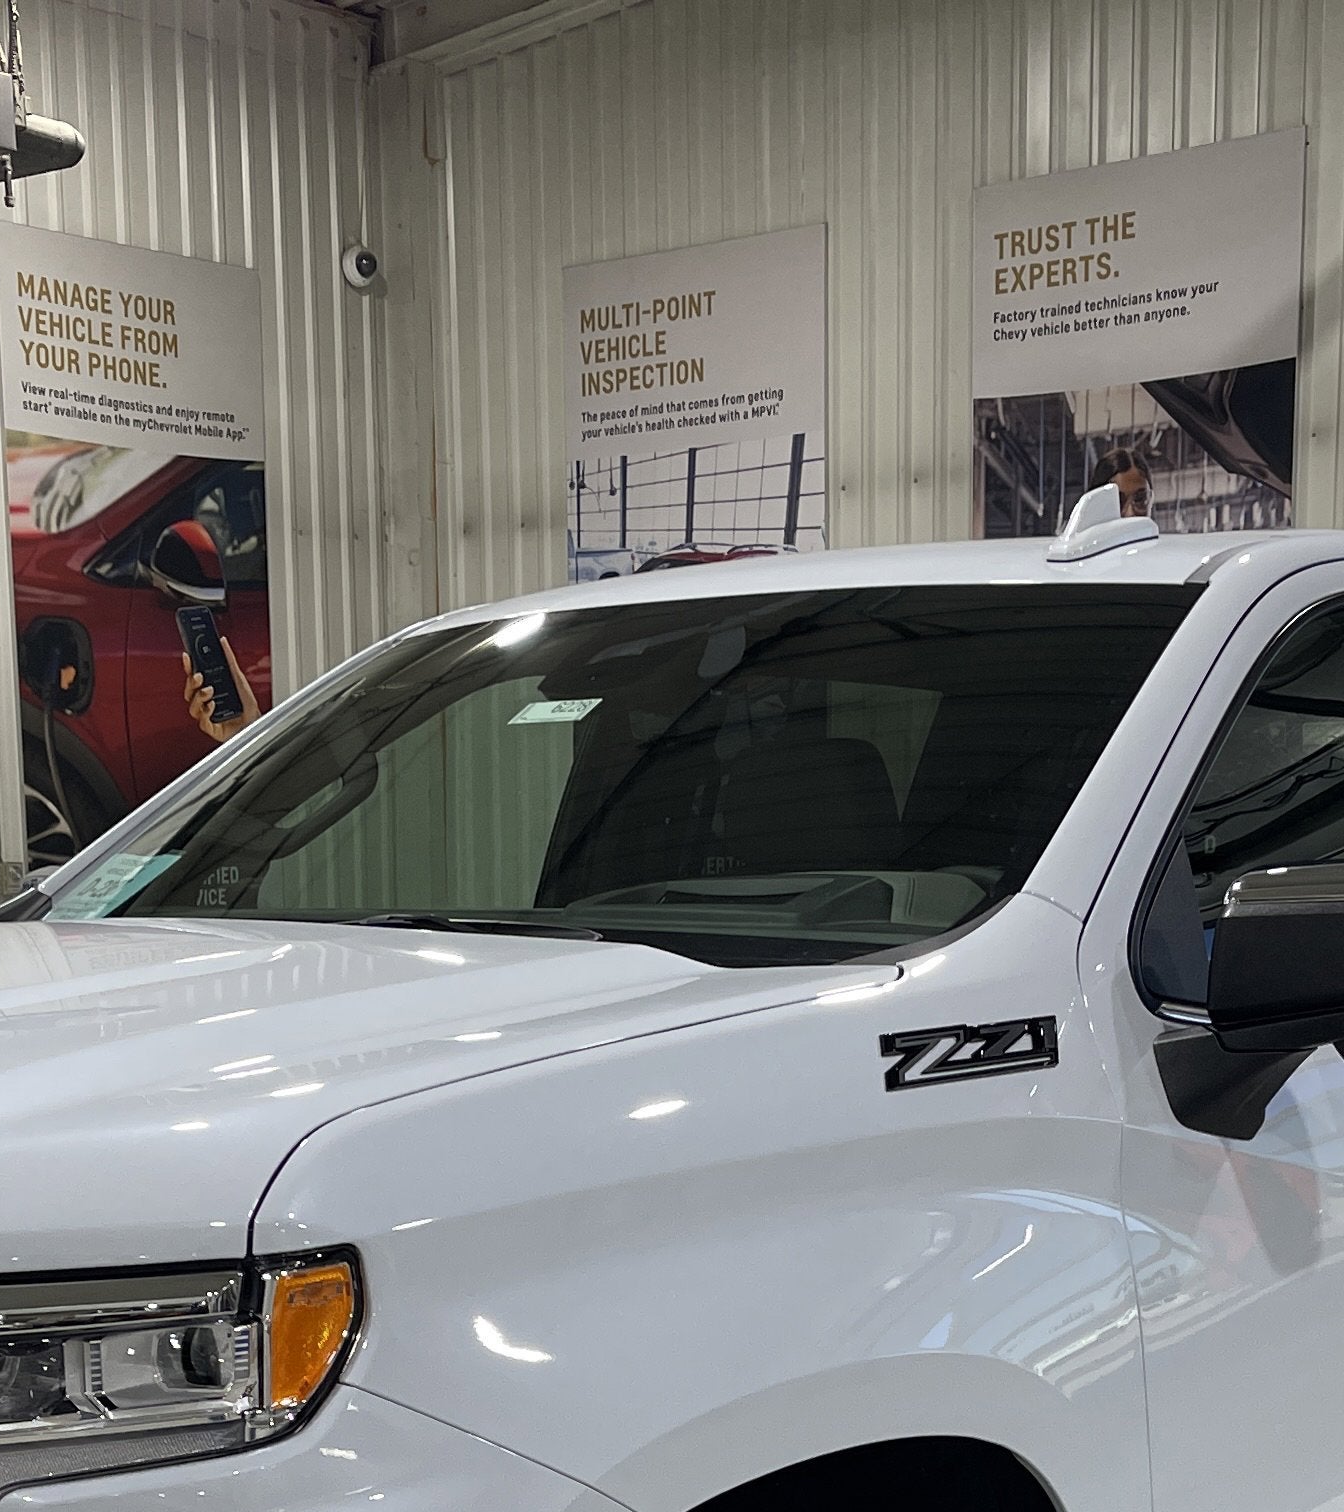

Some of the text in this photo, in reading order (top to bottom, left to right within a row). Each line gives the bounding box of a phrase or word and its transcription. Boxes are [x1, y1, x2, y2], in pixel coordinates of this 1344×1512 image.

[994, 210, 1136, 260] TRUST THE
[995, 252, 1120, 295] EXPERTS.
[17, 272, 176, 326] MANAGE YOUR
[580, 290, 716, 334] MULTI-POINT
[993, 281, 1220, 324] Factory trained technicians know your
[18, 305, 179, 358] VEHICLE FROM
[993, 305, 1191, 342] Chevy vehicle better than anyone.
[19, 339, 167, 388] YOUR PHONE.
[580, 330, 667, 365] VEHICLE
[581, 357, 705, 398] INSPECTION
[21, 381, 235, 423] View real-time diagnostics and enjoy remote
[54, 406, 98, 422] available
[100, 414, 112, 424] on
[114, 414, 130, 426] the
[133, 418, 193, 435] myChevrolet
[195, 424, 223, 438] Mobile
[581, 387, 784, 424] The peace of mind that comes from getting
[581, 429, 602, 442] your
[604, 421, 642, 436] vehicle's
[646, 418, 675, 431] health
[678, 412, 716, 426] checked
[719, 409, 740, 422] with
[743, 411, 748, 420] a
